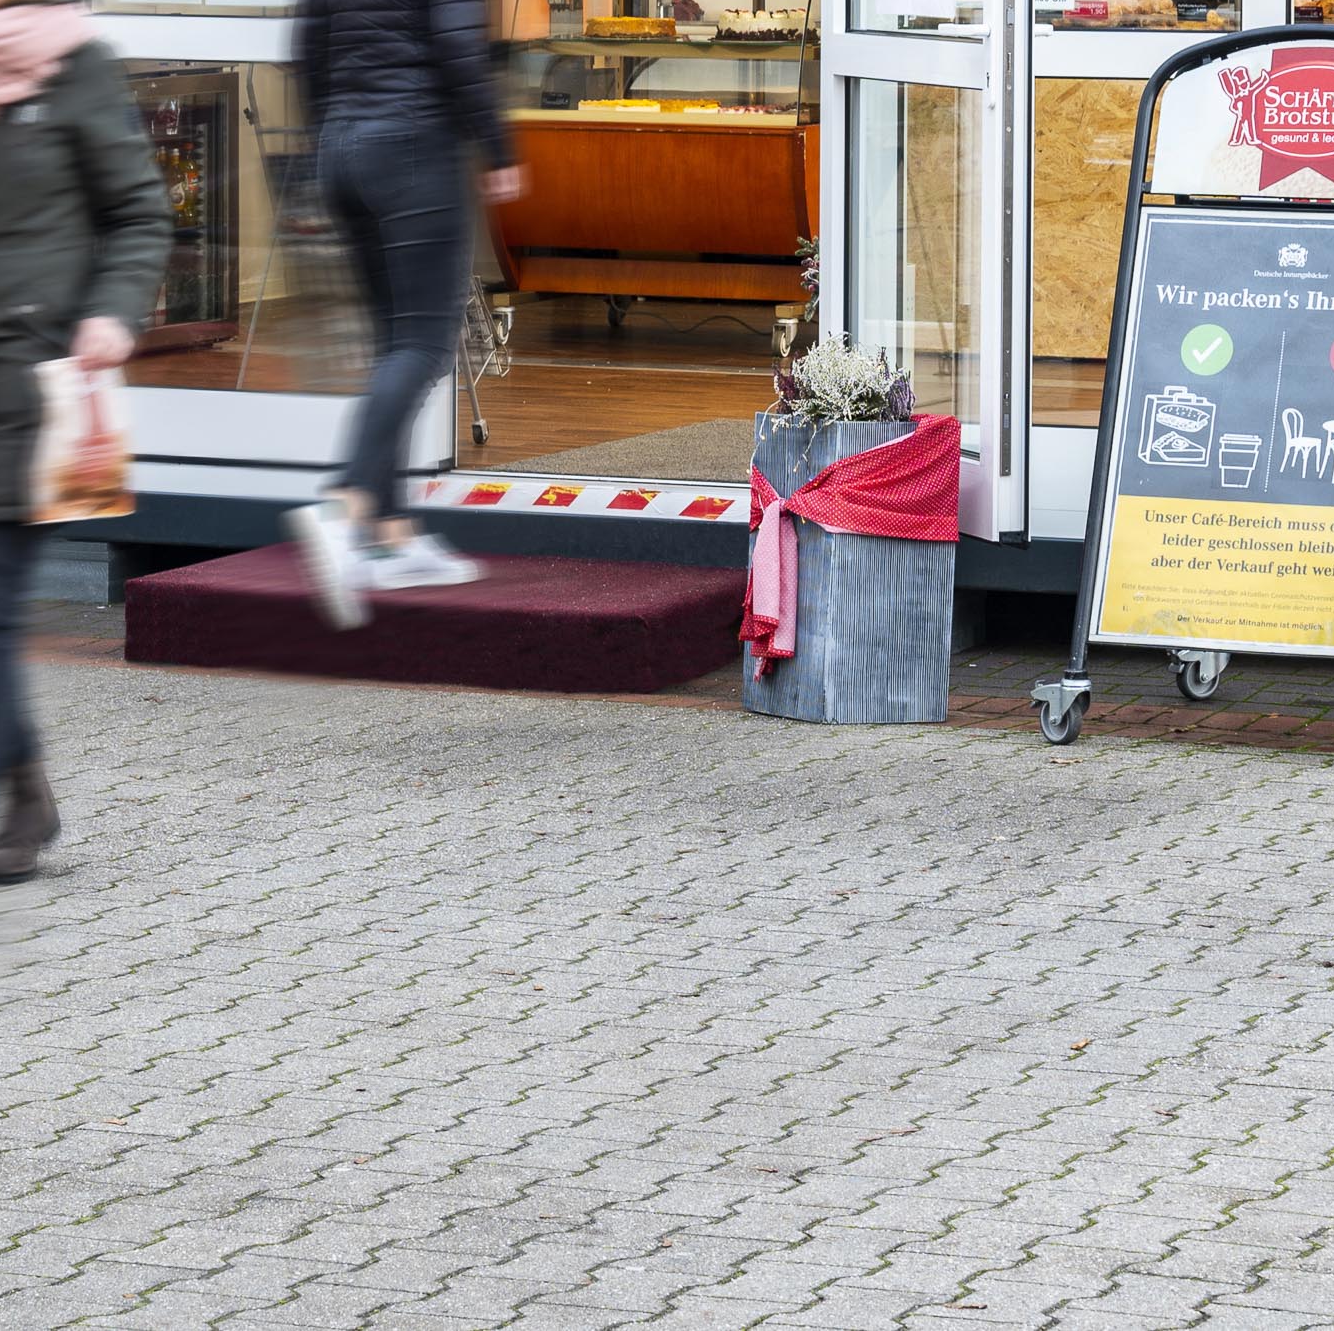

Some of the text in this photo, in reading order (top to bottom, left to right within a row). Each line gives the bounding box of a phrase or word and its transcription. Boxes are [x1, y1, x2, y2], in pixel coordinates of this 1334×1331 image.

[1271, 133, 1309, 145] gesund
[1311, 134, 1320, 142] &
[1253, 270, 1282, 278] Deutsche
[1155, 284, 1198, 305] Wir
[1144, 509, 1188, 524] Unser
[1191, 512, 1283, 530] Café-Bereich
[1287, 520, 1326, 532] muss
[1162, 533, 1205, 548] leider
[1208, 536, 1294, 553] geschlossen
[1150, 555, 1184, 569] aber
[1187, 557, 1213, 571] der
[1217, 558, 1274, 574] Verkauf
[1276, 562, 1308, 578] geht
[1176, 614, 1324, 631] Der Verkauf zur Mitnahme ist möglich.
